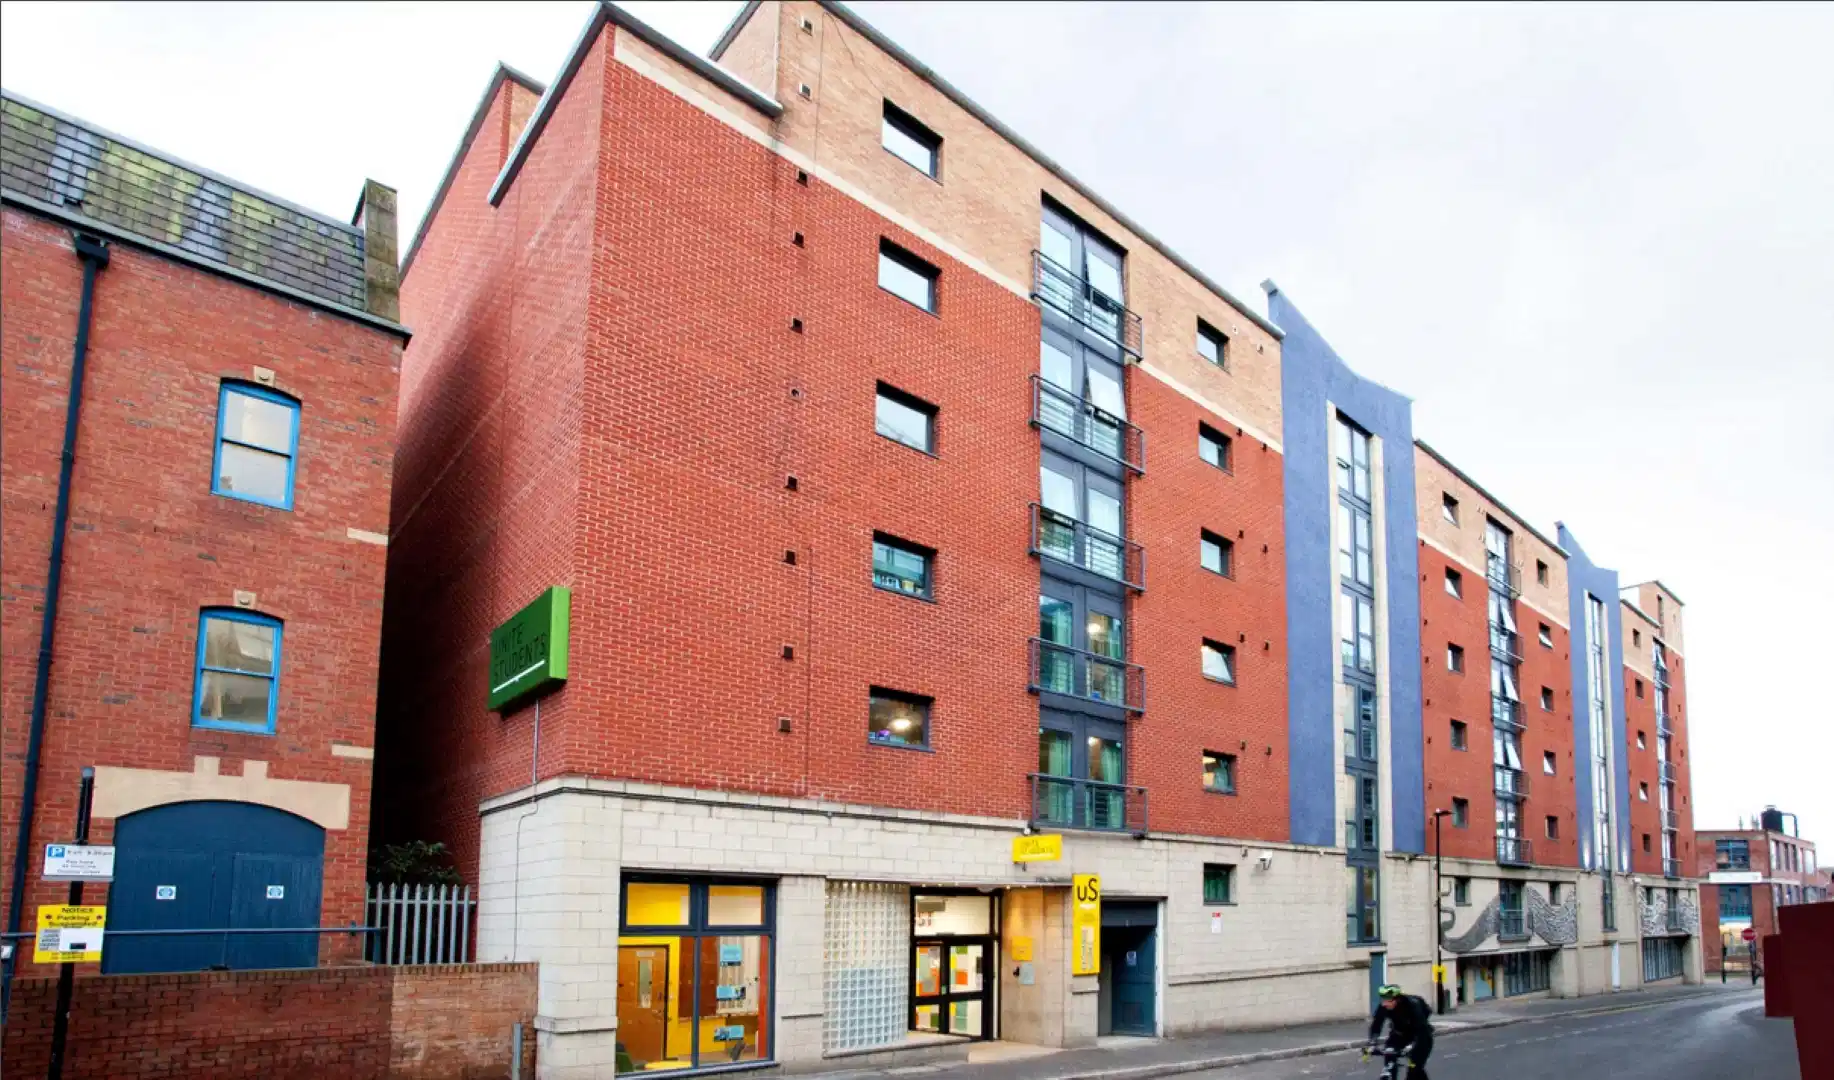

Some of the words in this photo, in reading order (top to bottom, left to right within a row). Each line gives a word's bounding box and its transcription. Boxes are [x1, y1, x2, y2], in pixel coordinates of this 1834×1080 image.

[494, 621, 525, 654] UNITE
[494, 631, 547, 687] STUDENTS
[1077, 878, 1098, 902] uS
[57, 914, 90, 922] Parking
